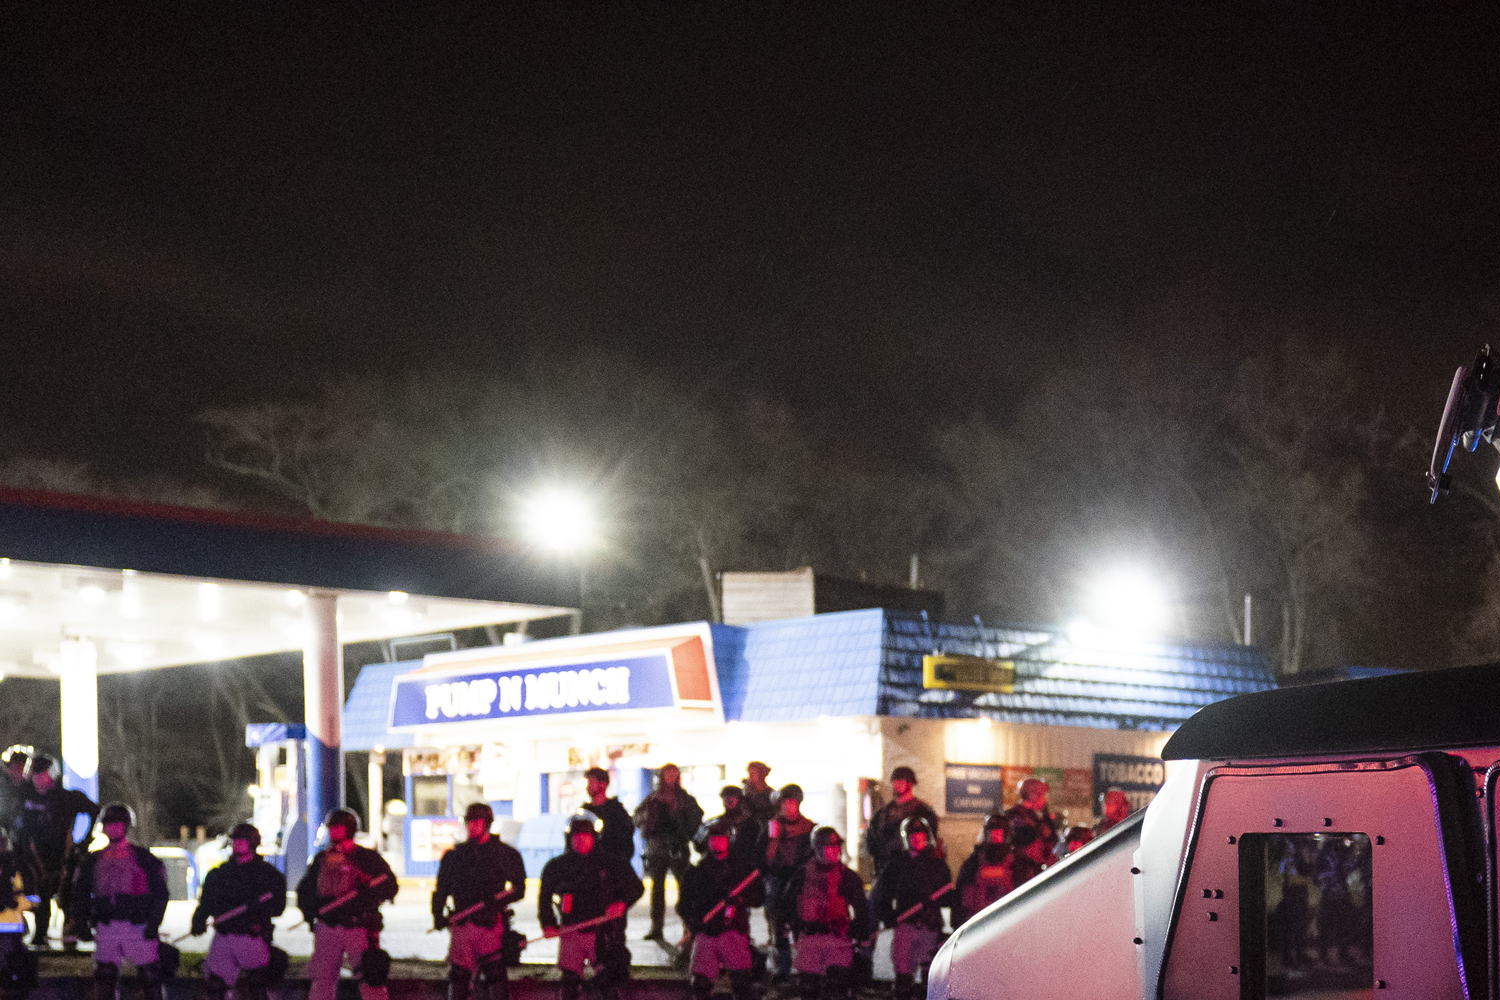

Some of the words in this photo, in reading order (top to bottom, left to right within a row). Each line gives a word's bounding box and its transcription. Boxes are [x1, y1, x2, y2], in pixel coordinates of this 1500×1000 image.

[425, 678, 497, 719] PUMP
[498, 675, 522, 713] N
[524, 666, 630, 711] MUNCH
[1099, 761, 1164, 786] TOBACCO
